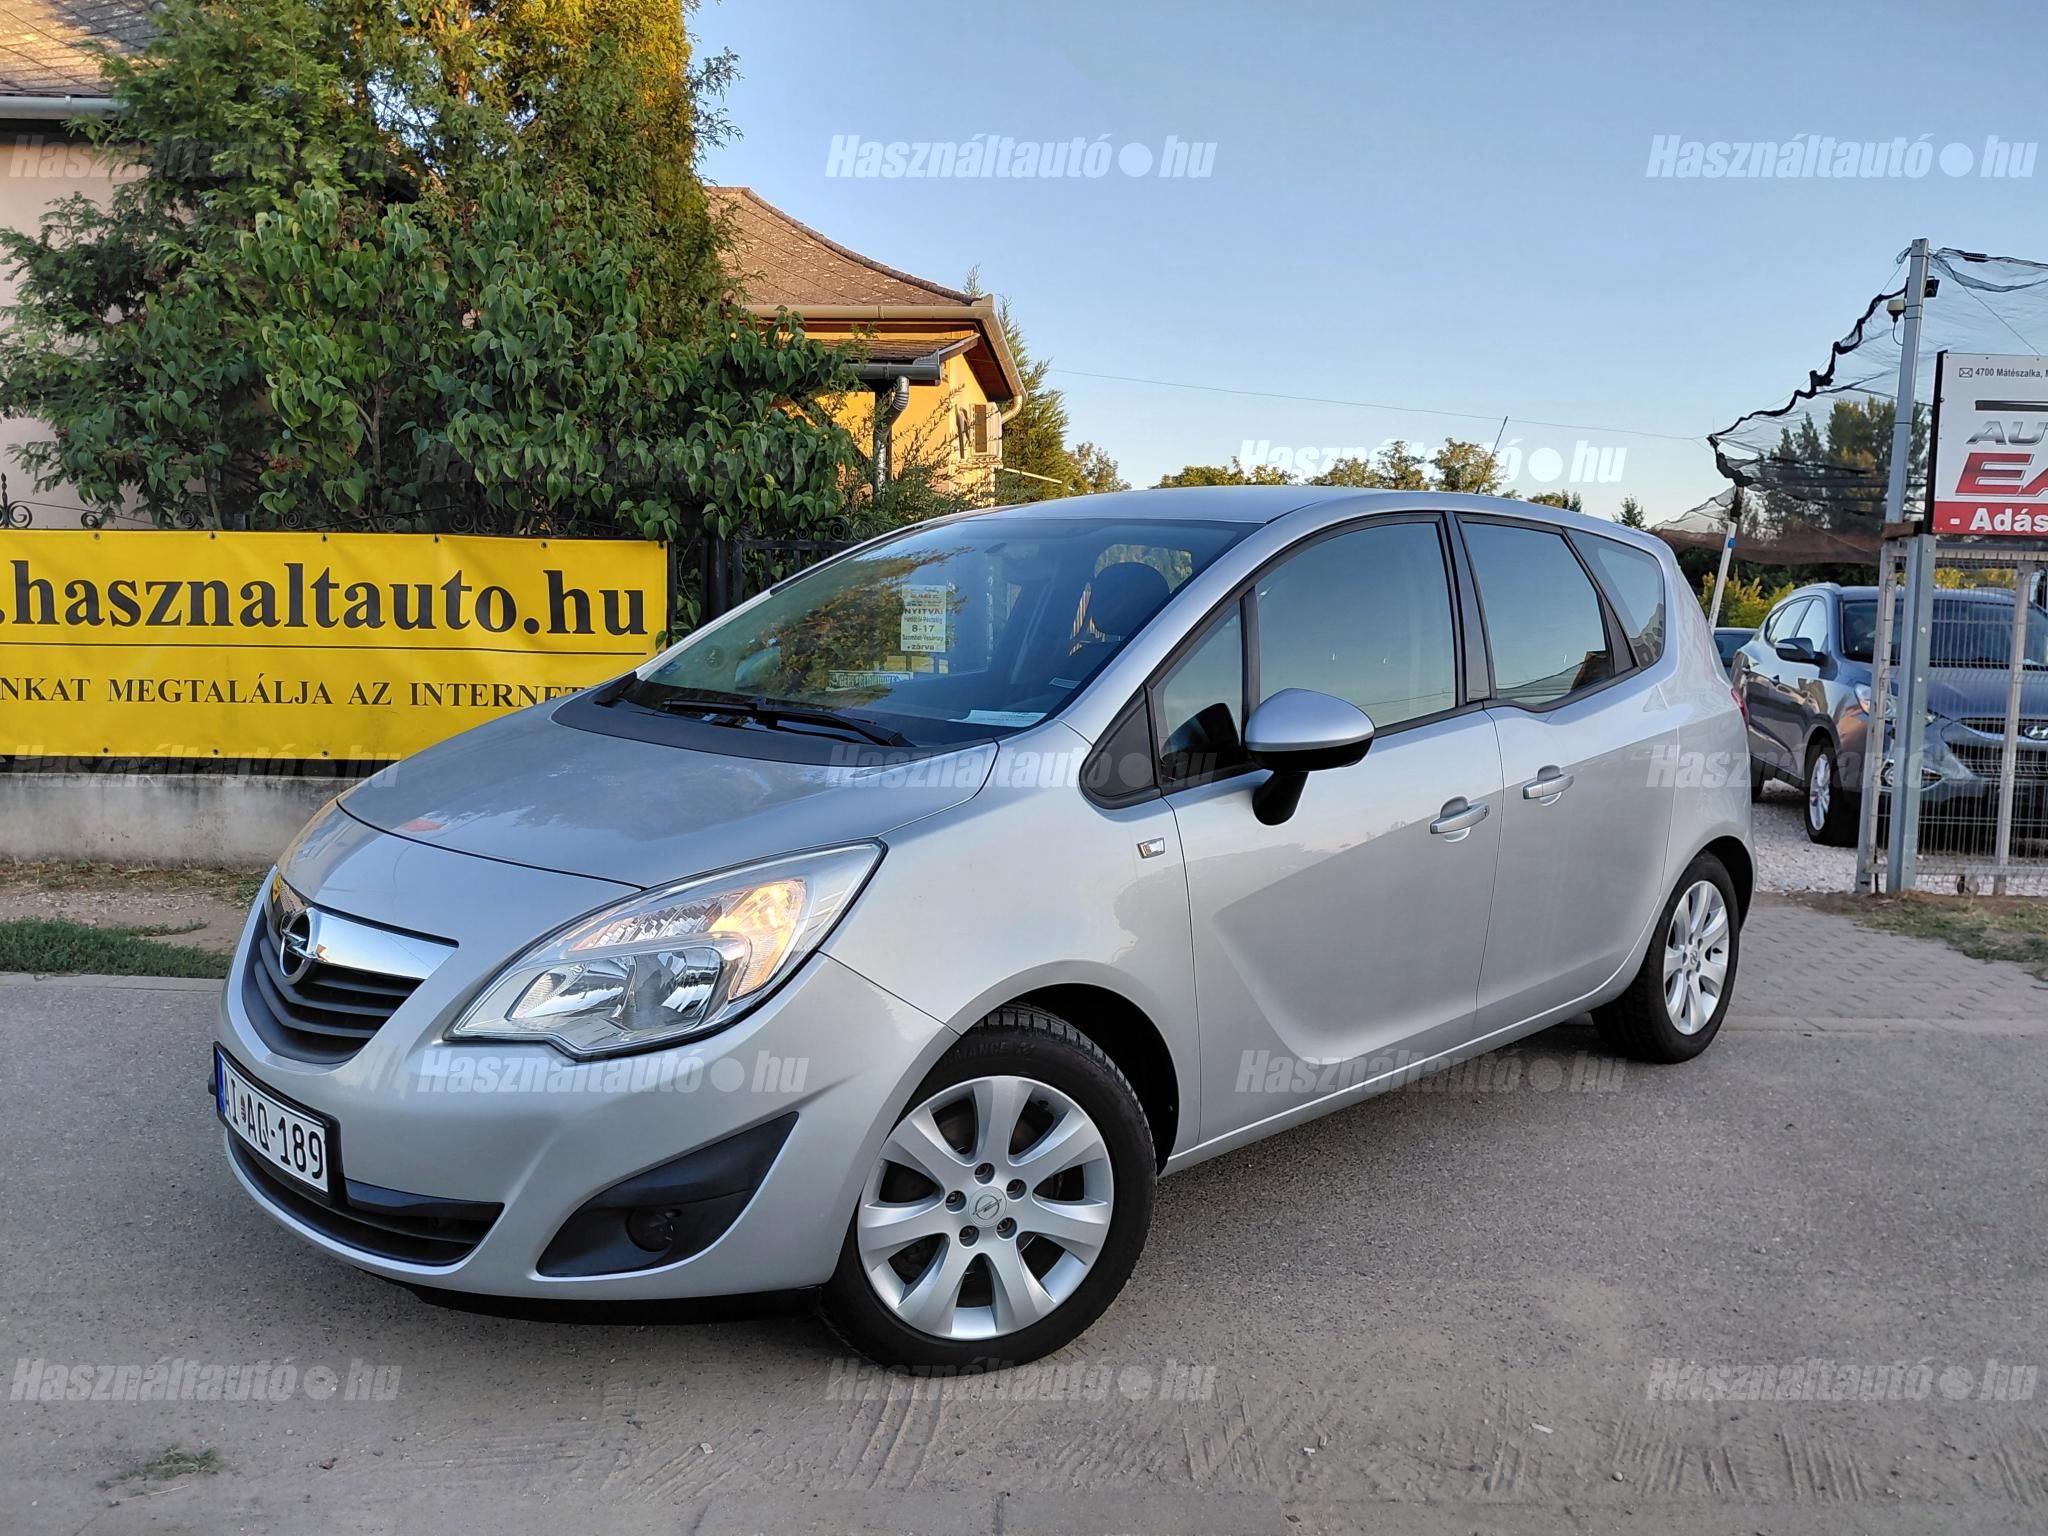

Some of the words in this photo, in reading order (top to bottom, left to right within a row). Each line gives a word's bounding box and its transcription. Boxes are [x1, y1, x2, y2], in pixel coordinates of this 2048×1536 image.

[1975, 367, 1995, 377] 4700
[1996, 367, 2043, 379] Mátészalka,
[1966, 420, 2048, 446] AU
[911, 624, 935, 633] 8-17
[107, 673, 334, 705] MEGTALÁLJA
[347, 681, 393, 706] AZ
[408, 682, 586, 708] INTERNE
[247, 1092, 325, 1180] AQ-189
